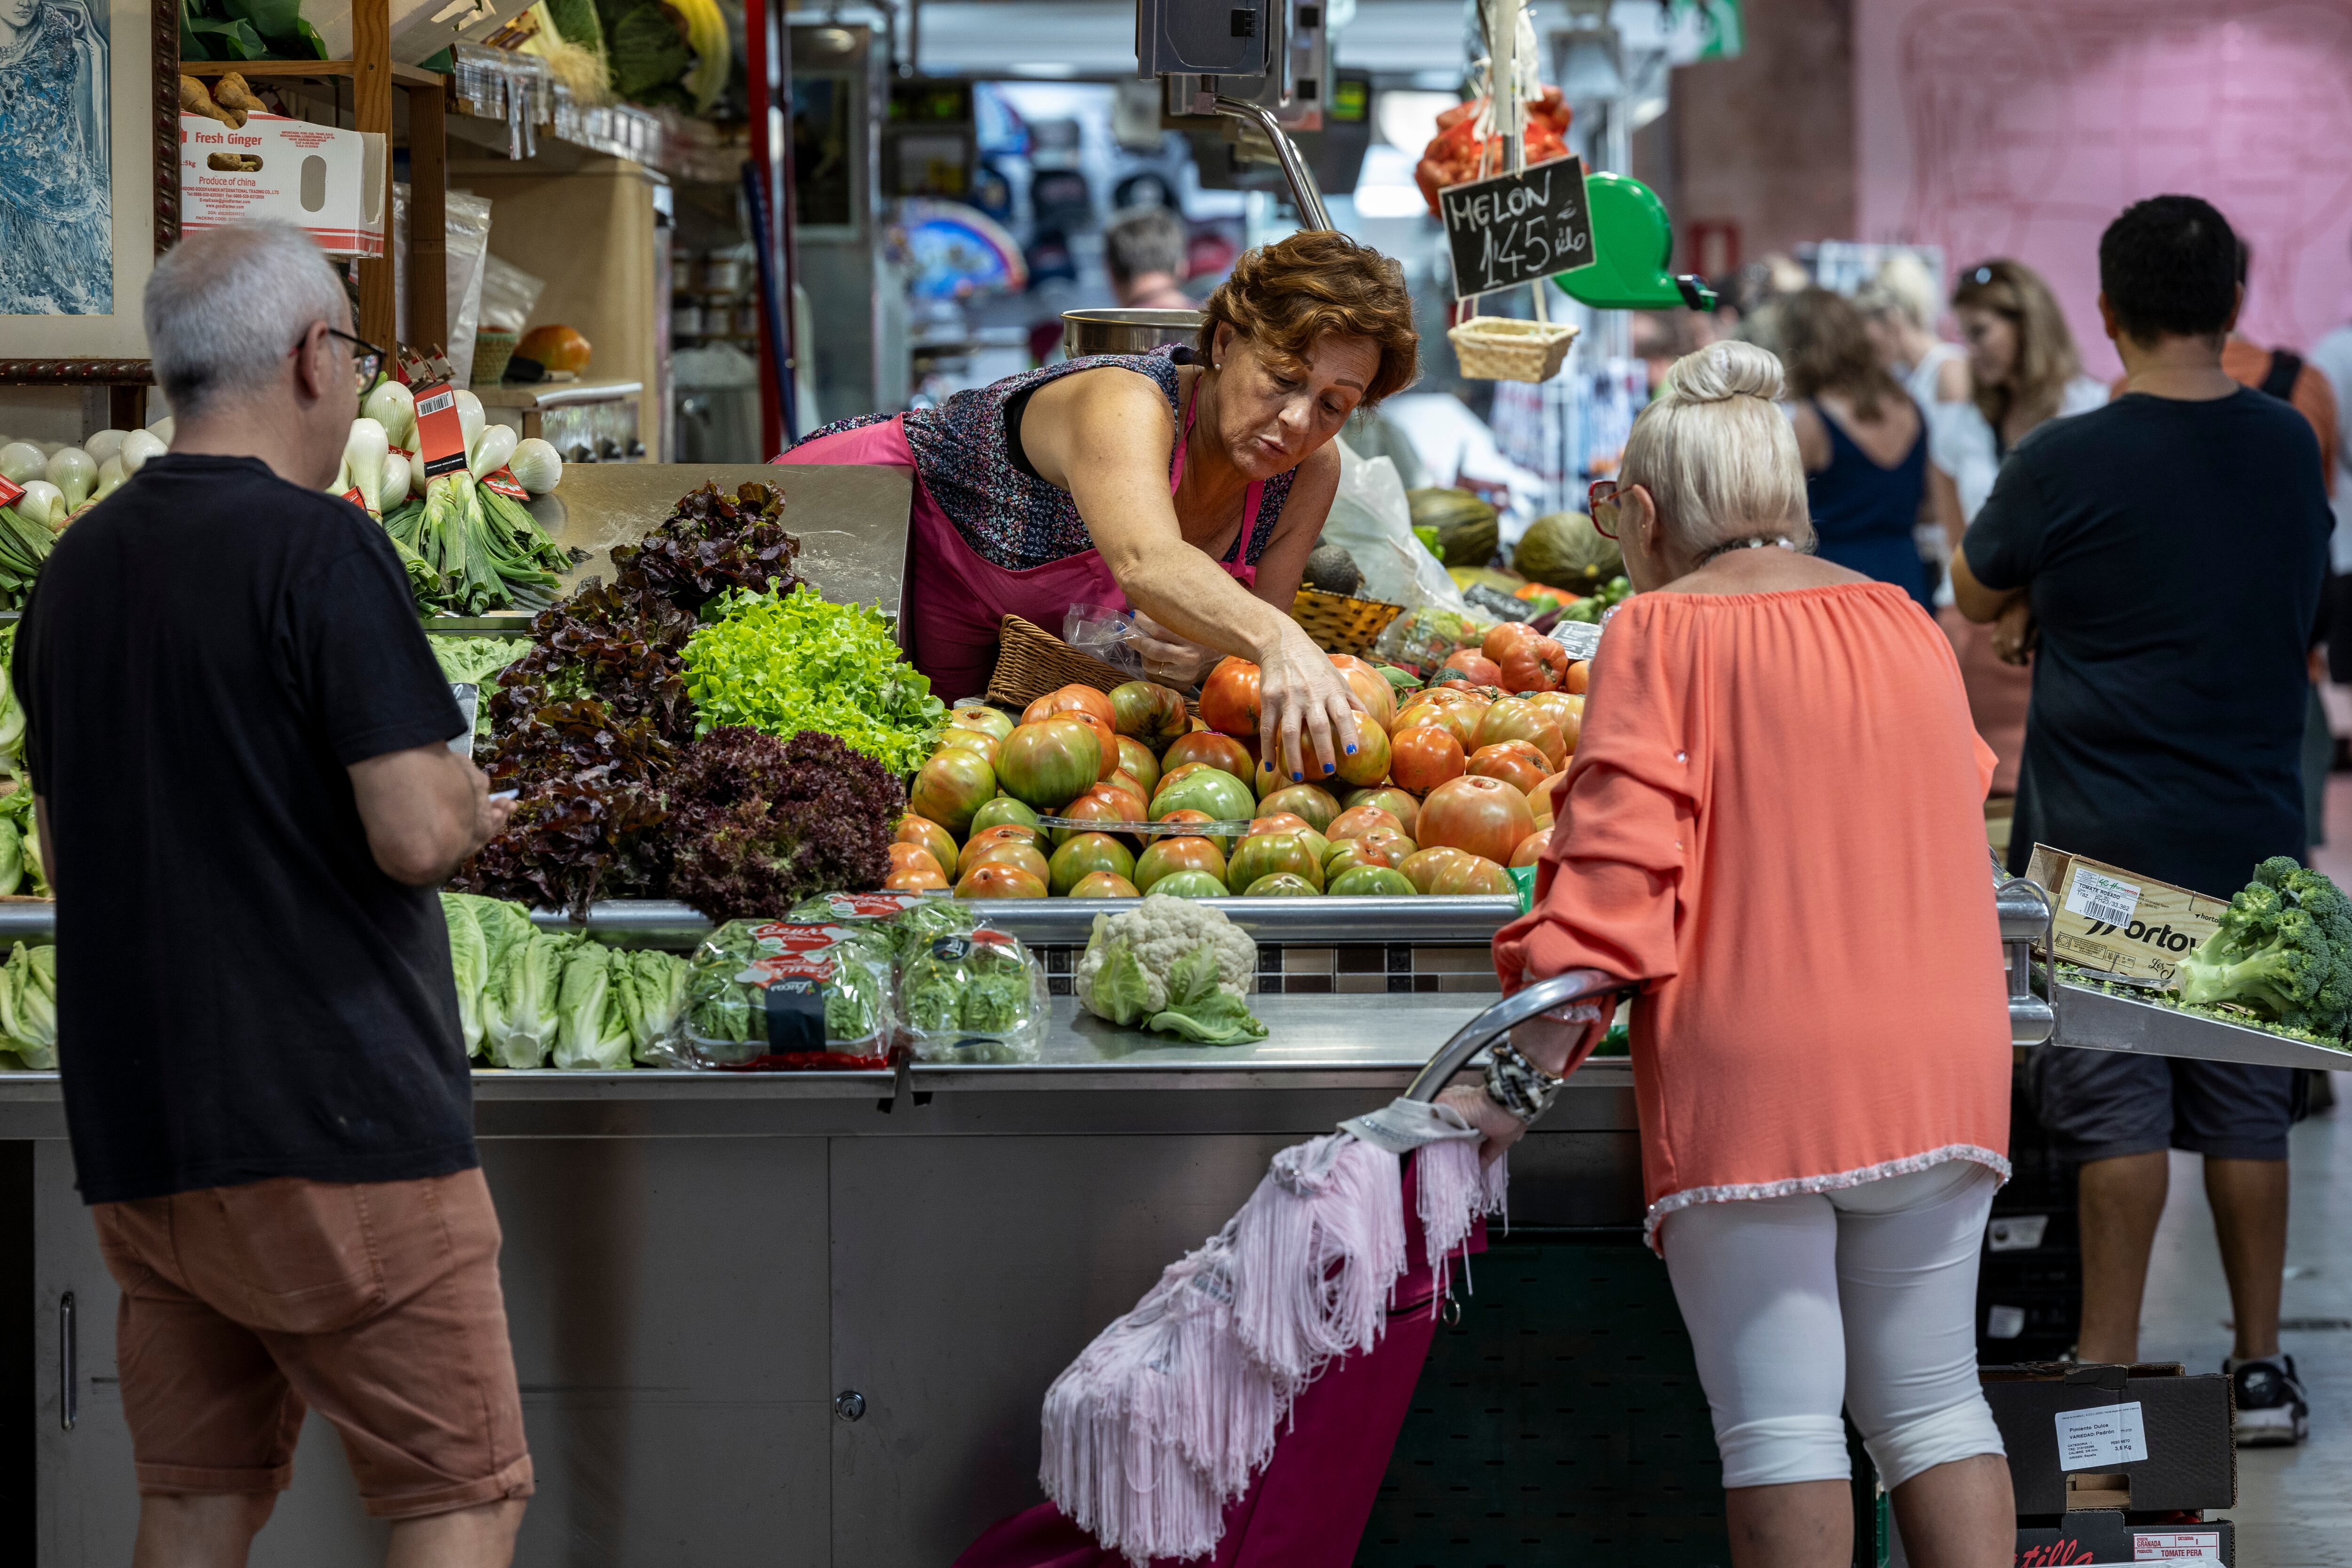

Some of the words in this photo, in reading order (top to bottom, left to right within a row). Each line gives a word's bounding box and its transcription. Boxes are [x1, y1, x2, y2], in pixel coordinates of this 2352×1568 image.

[195, 132, 223, 143] Fresh
[227, 133, 262, 147] Ginger
[199, 177, 227, 185] Produce
[237, 178, 255, 186] china
[1447, 169, 1551, 232] MELON
[2079, 883, 2098, 893] TOMATE
[2100, 890, 2120, 899] ROSADO
[2095, 896, 2130, 911] PH23/33.362
[2108, 919, 2126, 927] 192269
[2148, 958, 2164, 970] Los
